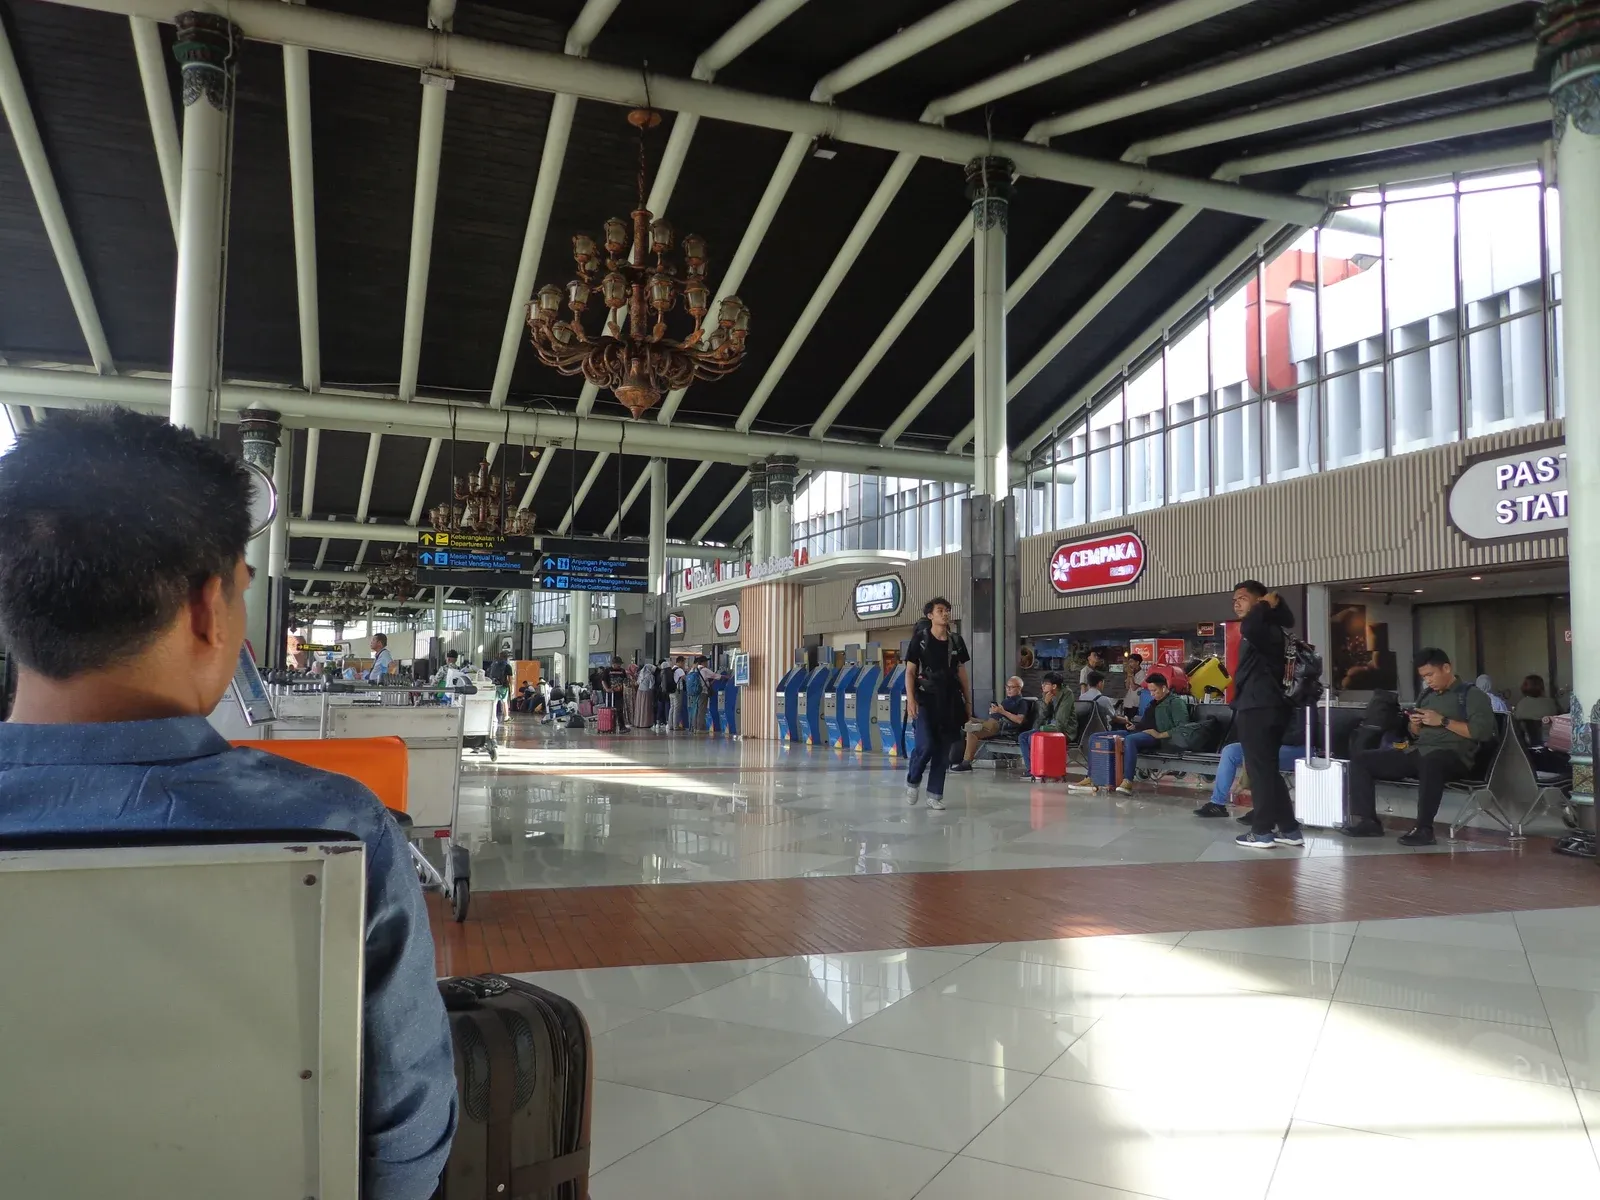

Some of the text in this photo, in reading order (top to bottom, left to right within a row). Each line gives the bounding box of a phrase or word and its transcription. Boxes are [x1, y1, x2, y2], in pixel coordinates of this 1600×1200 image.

[1496, 453, 1567, 490] PAS
[450, 534, 495, 542] Keberangkatan
[450, 540, 483, 548] Departures
[793, 546, 809, 568] 1A
[1069, 541, 1137, 568] CEMPAKA
[468, 560, 492, 568] Vending
